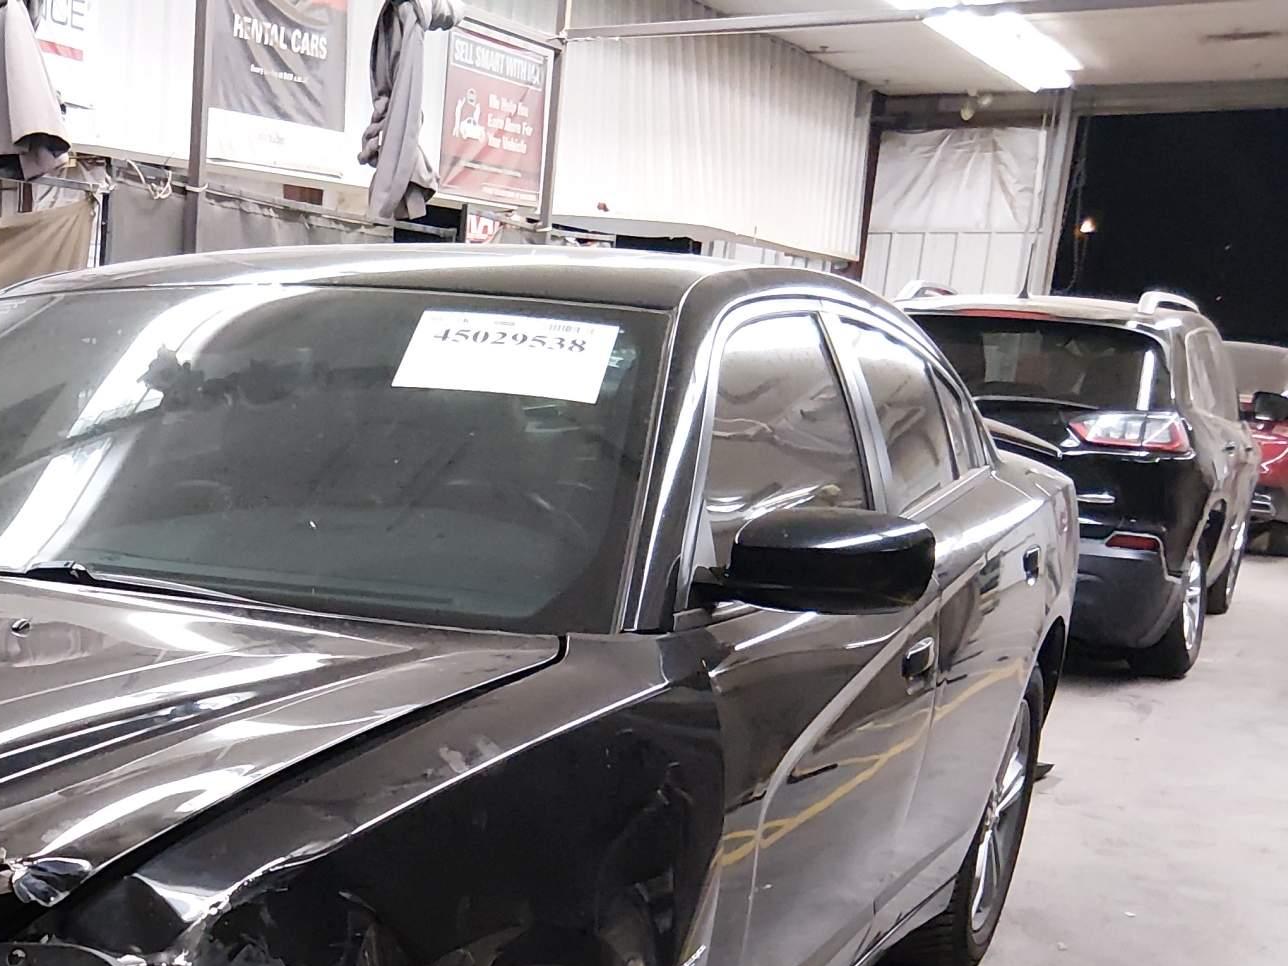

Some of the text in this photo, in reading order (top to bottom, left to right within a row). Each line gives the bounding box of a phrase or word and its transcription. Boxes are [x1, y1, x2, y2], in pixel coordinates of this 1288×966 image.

[233, 14, 327, 60] RENTAL CARS
[454, 39, 474, 65] SELL
[475, 46, 505, 73] SMART
[506, 55, 527, 80] WITH
[433, 328, 587, 353] 45029538
